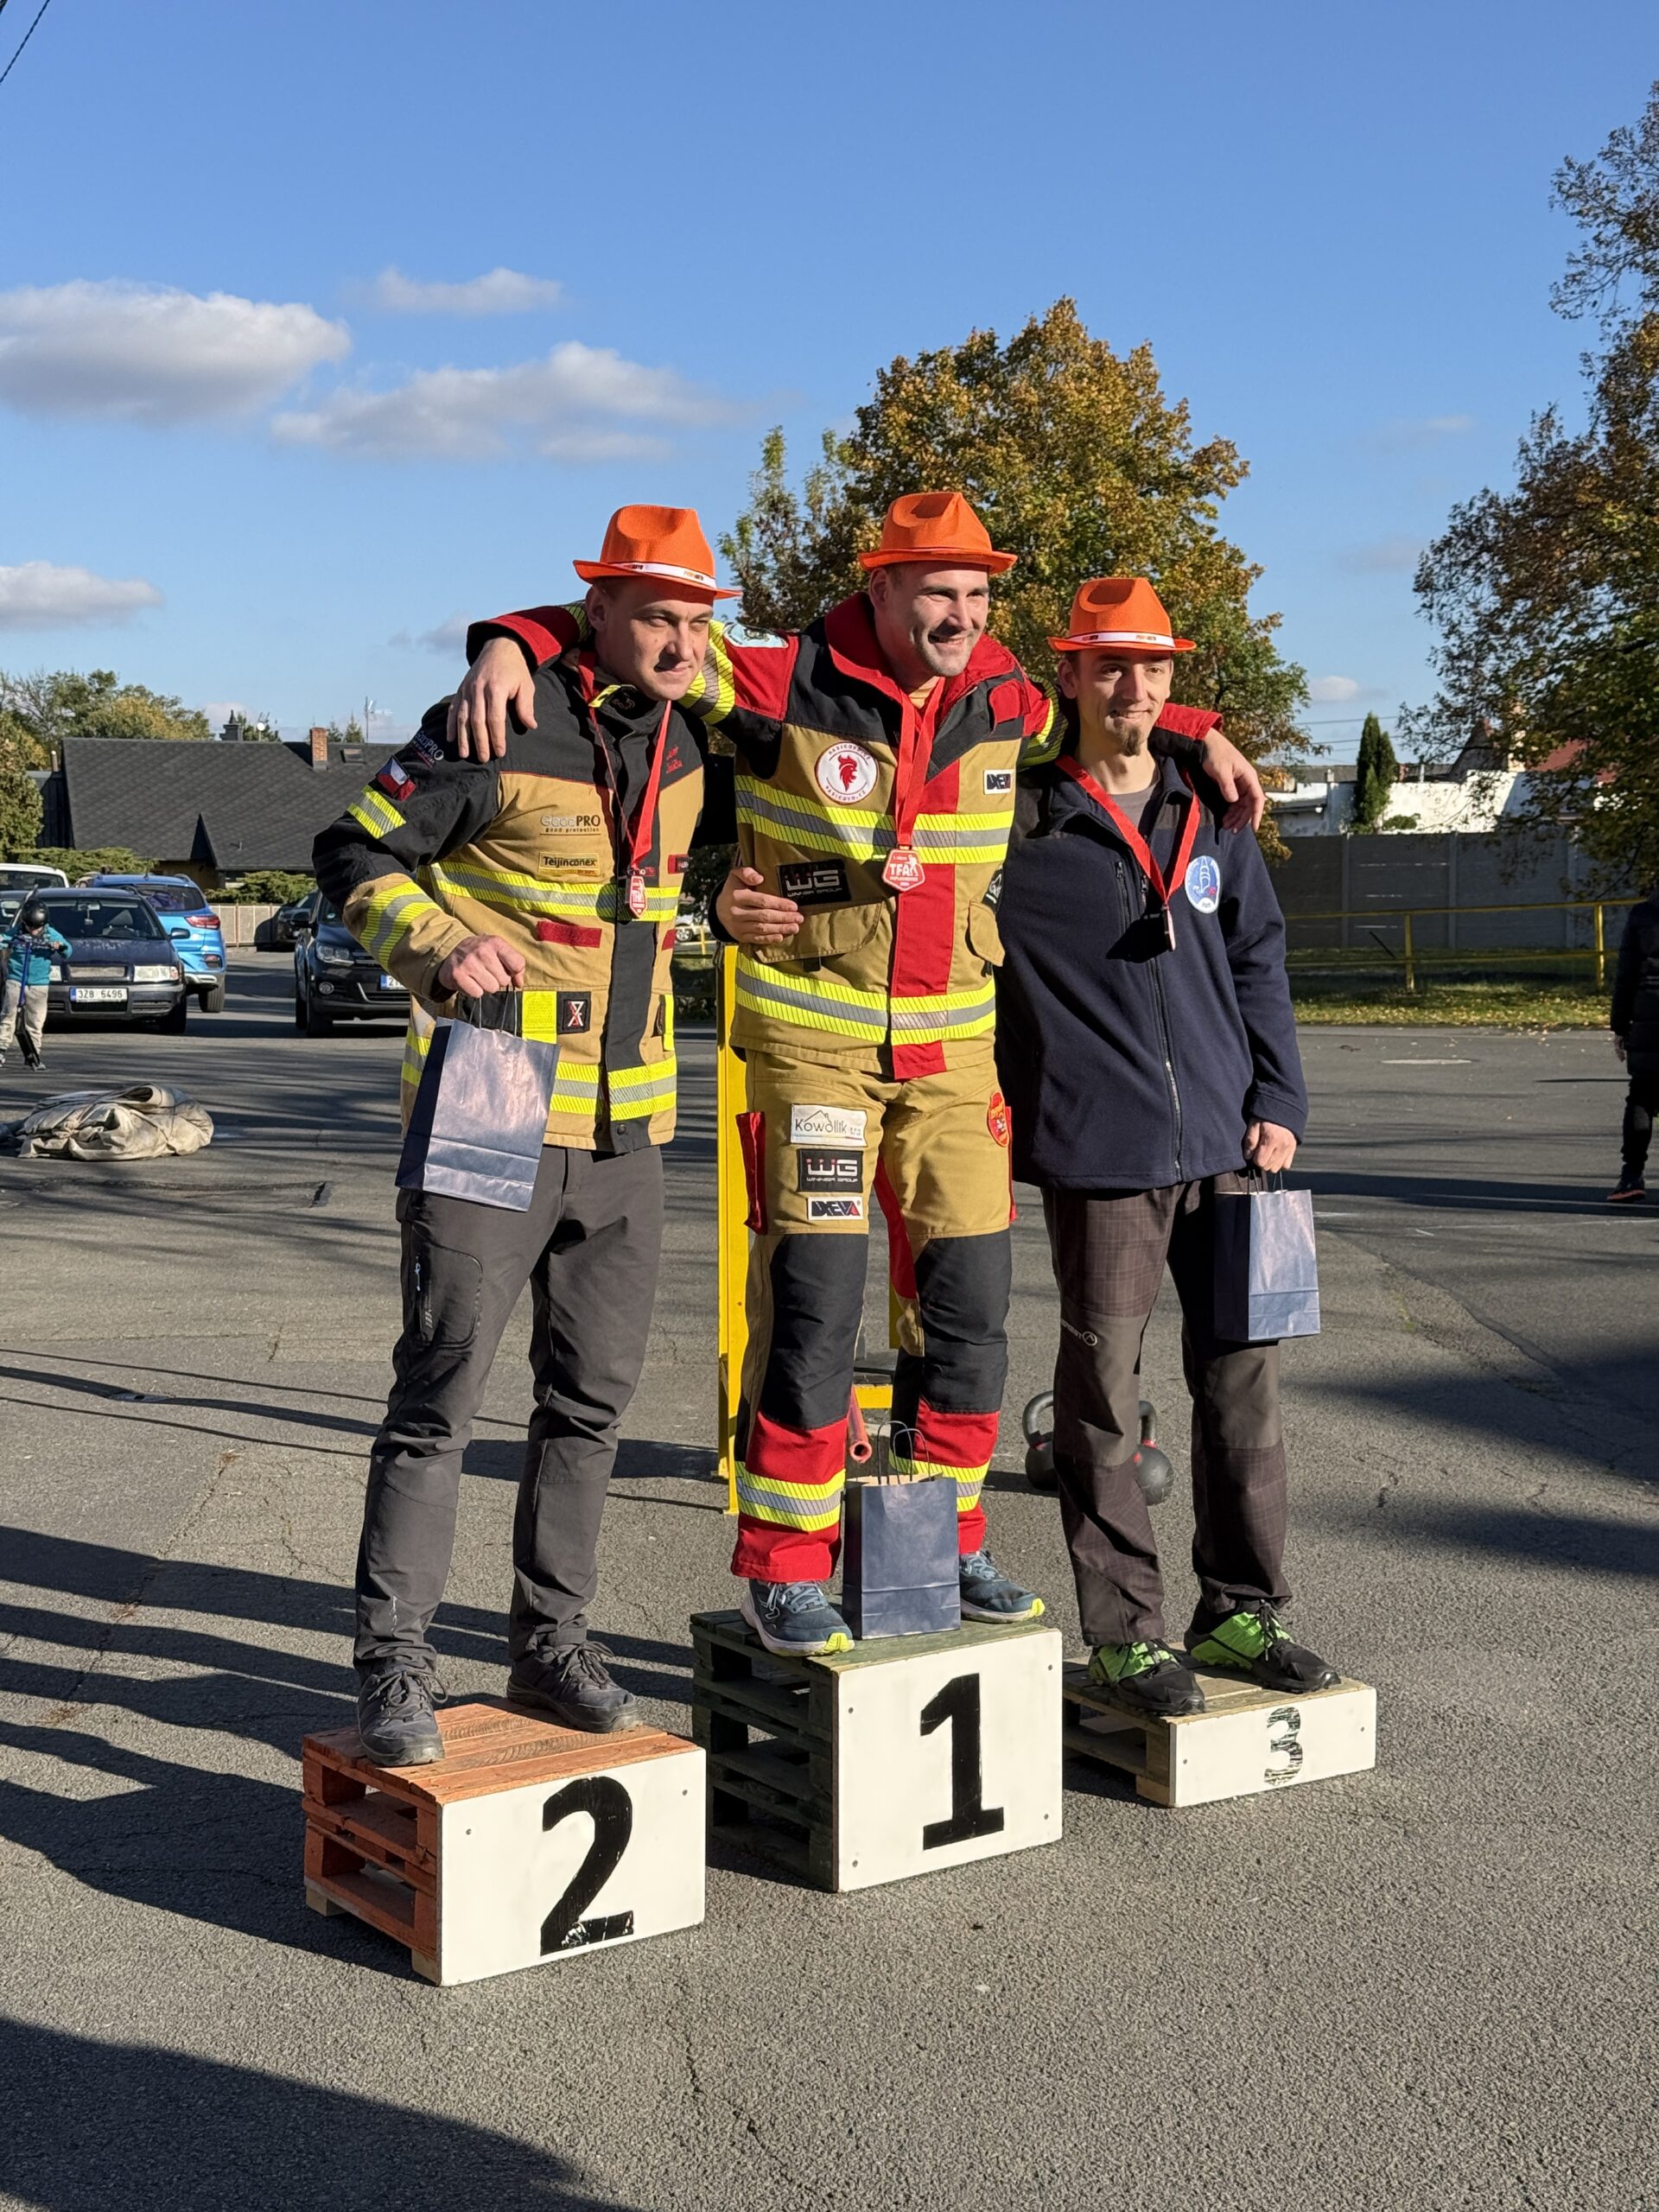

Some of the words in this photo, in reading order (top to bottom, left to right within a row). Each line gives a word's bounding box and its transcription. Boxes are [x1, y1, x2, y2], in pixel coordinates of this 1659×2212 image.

[543, 855, 598, 868] Teijinconex
[795, 1118, 847, 1134] Kowollik
[918, 1673, 1005, 1850] 1
[1262, 1707, 1306, 1786] 3
[539, 1775, 634, 1956] 2
